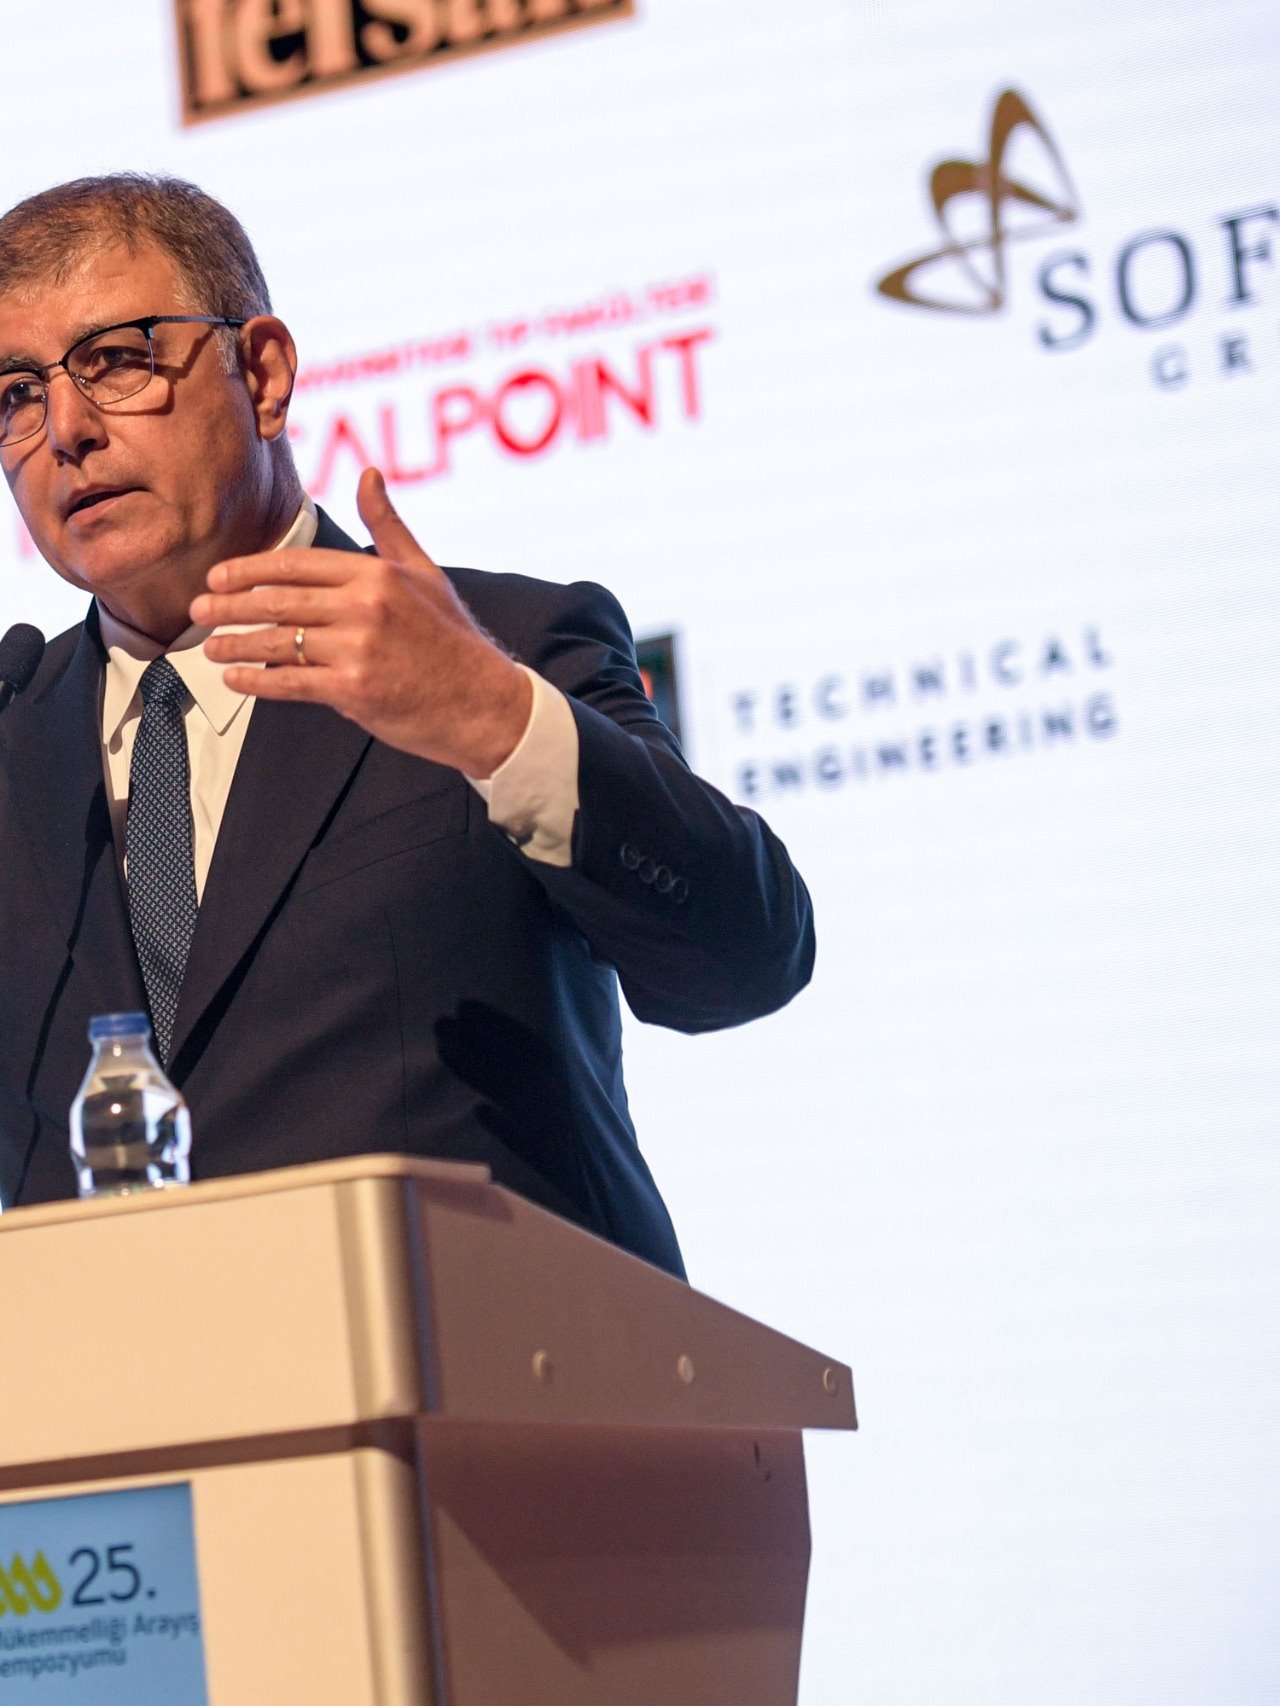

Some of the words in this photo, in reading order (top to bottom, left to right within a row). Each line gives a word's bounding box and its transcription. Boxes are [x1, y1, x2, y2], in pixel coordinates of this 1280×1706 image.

[288, 328, 712, 498] ALPOINT
[732, 622, 1113, 734] TECHNICAL
[736, 694, 1121, 800] ENGINEERING
[68, 1543, 158, 1609] 25.
